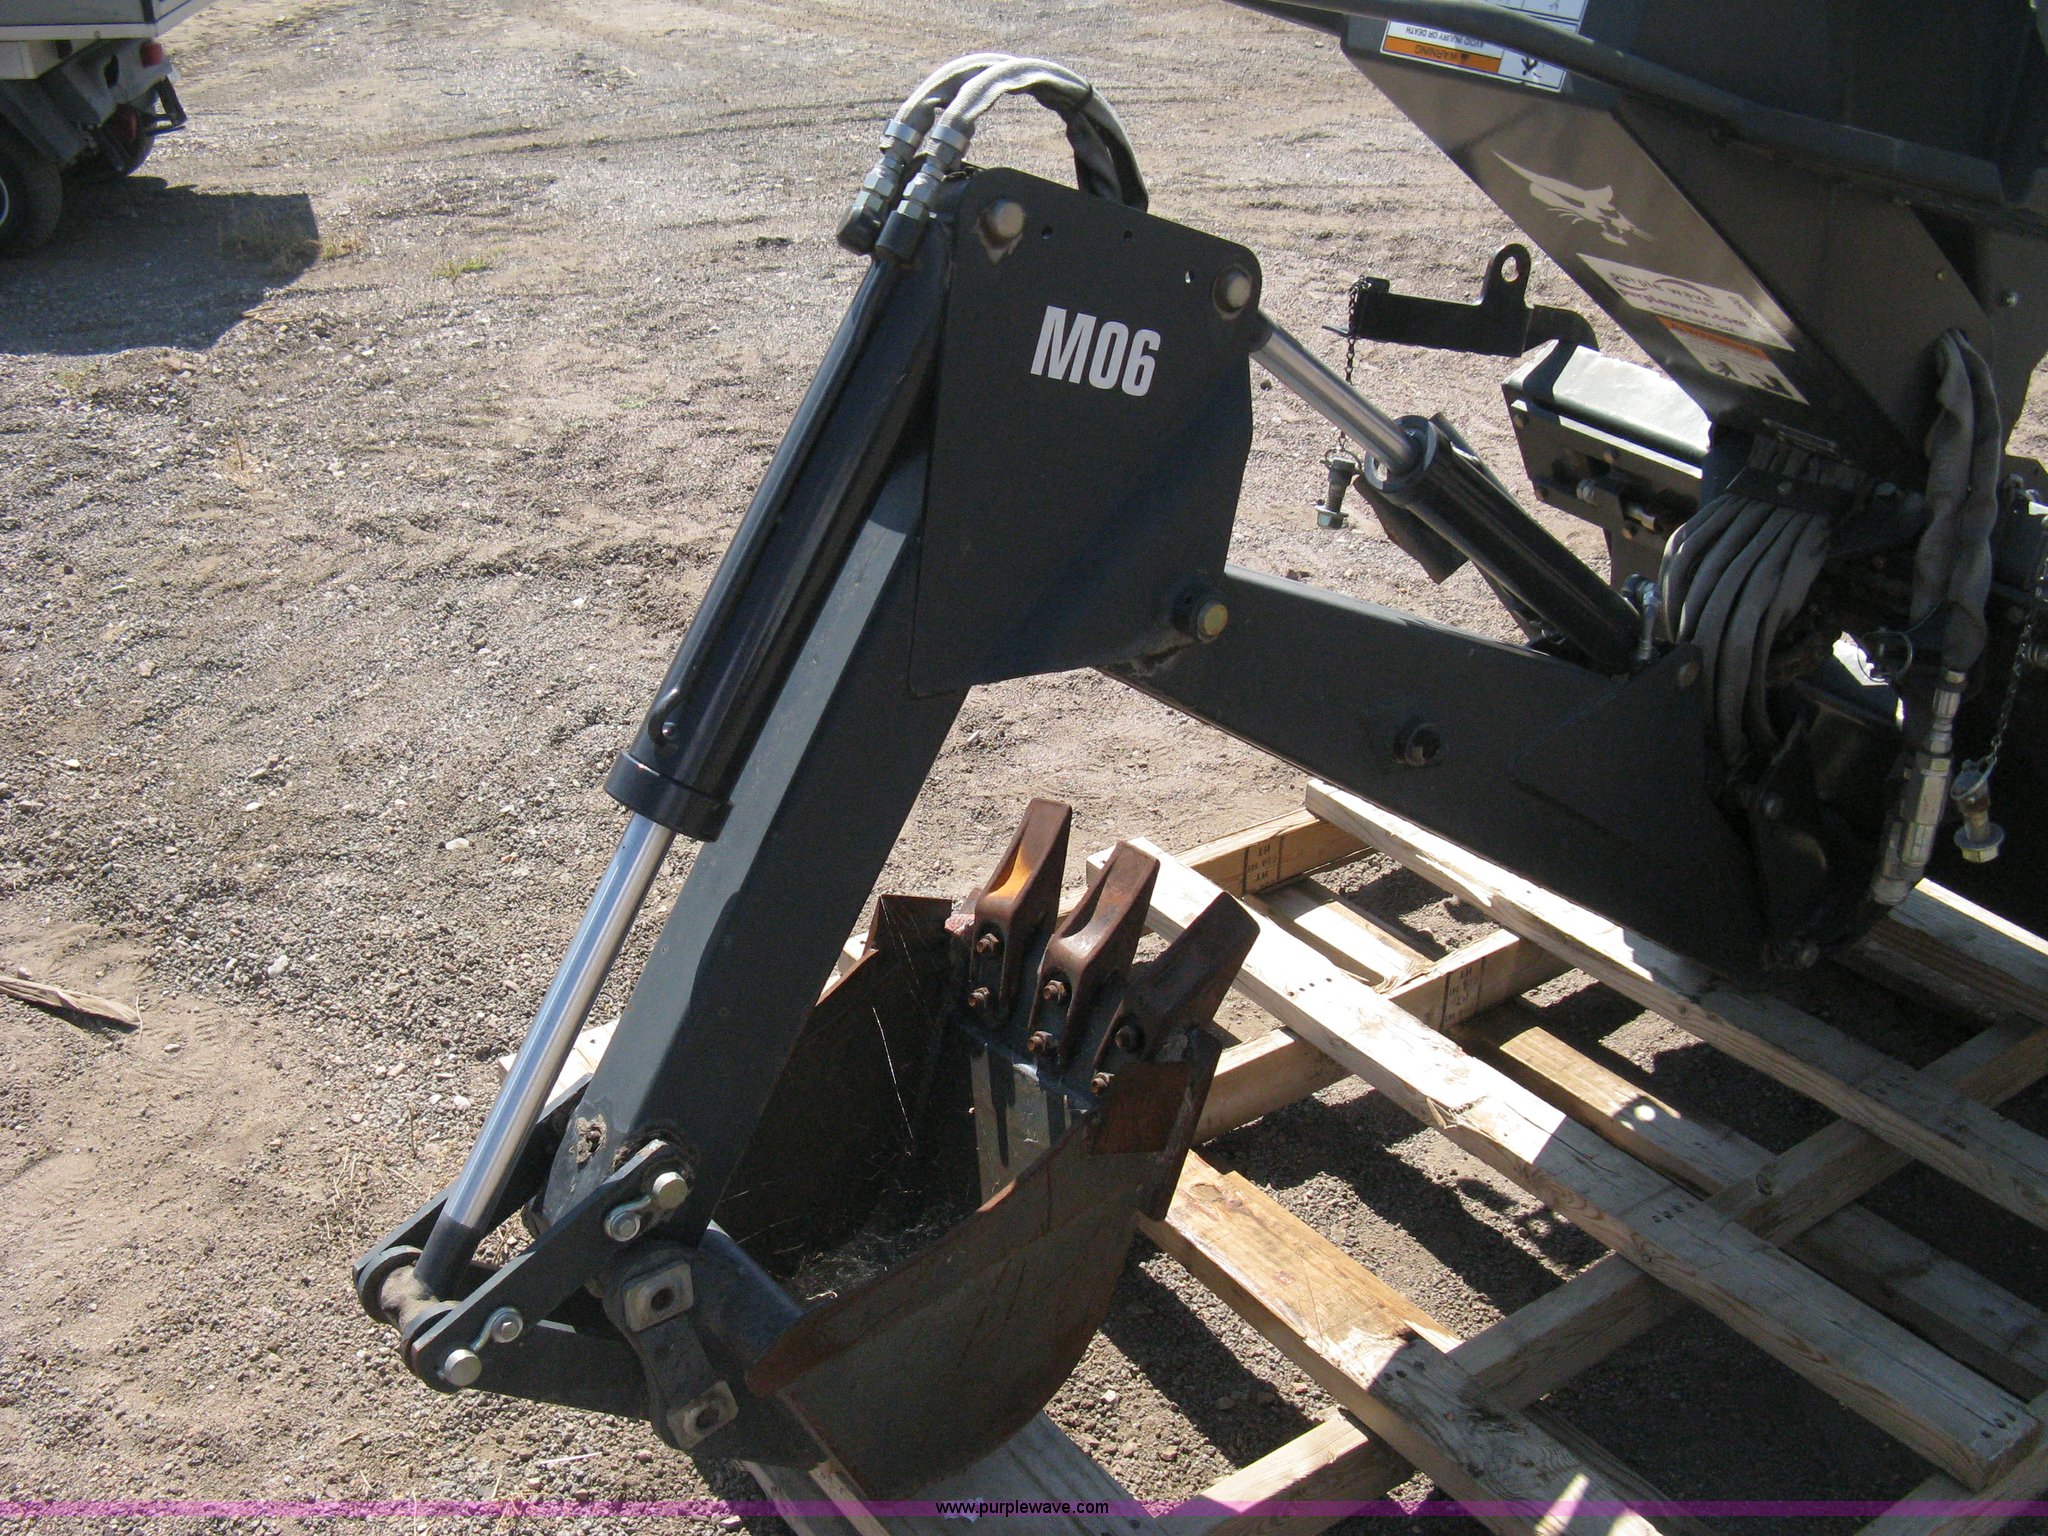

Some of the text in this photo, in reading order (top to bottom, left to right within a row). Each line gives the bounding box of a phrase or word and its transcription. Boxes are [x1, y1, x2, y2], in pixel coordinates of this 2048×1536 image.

[1405, 26, 1484, 48] AVOID INJURY OR DEATH
[1414, 44, 1458, 59] WARNING
[1031, 306, 1161, 397] M06
